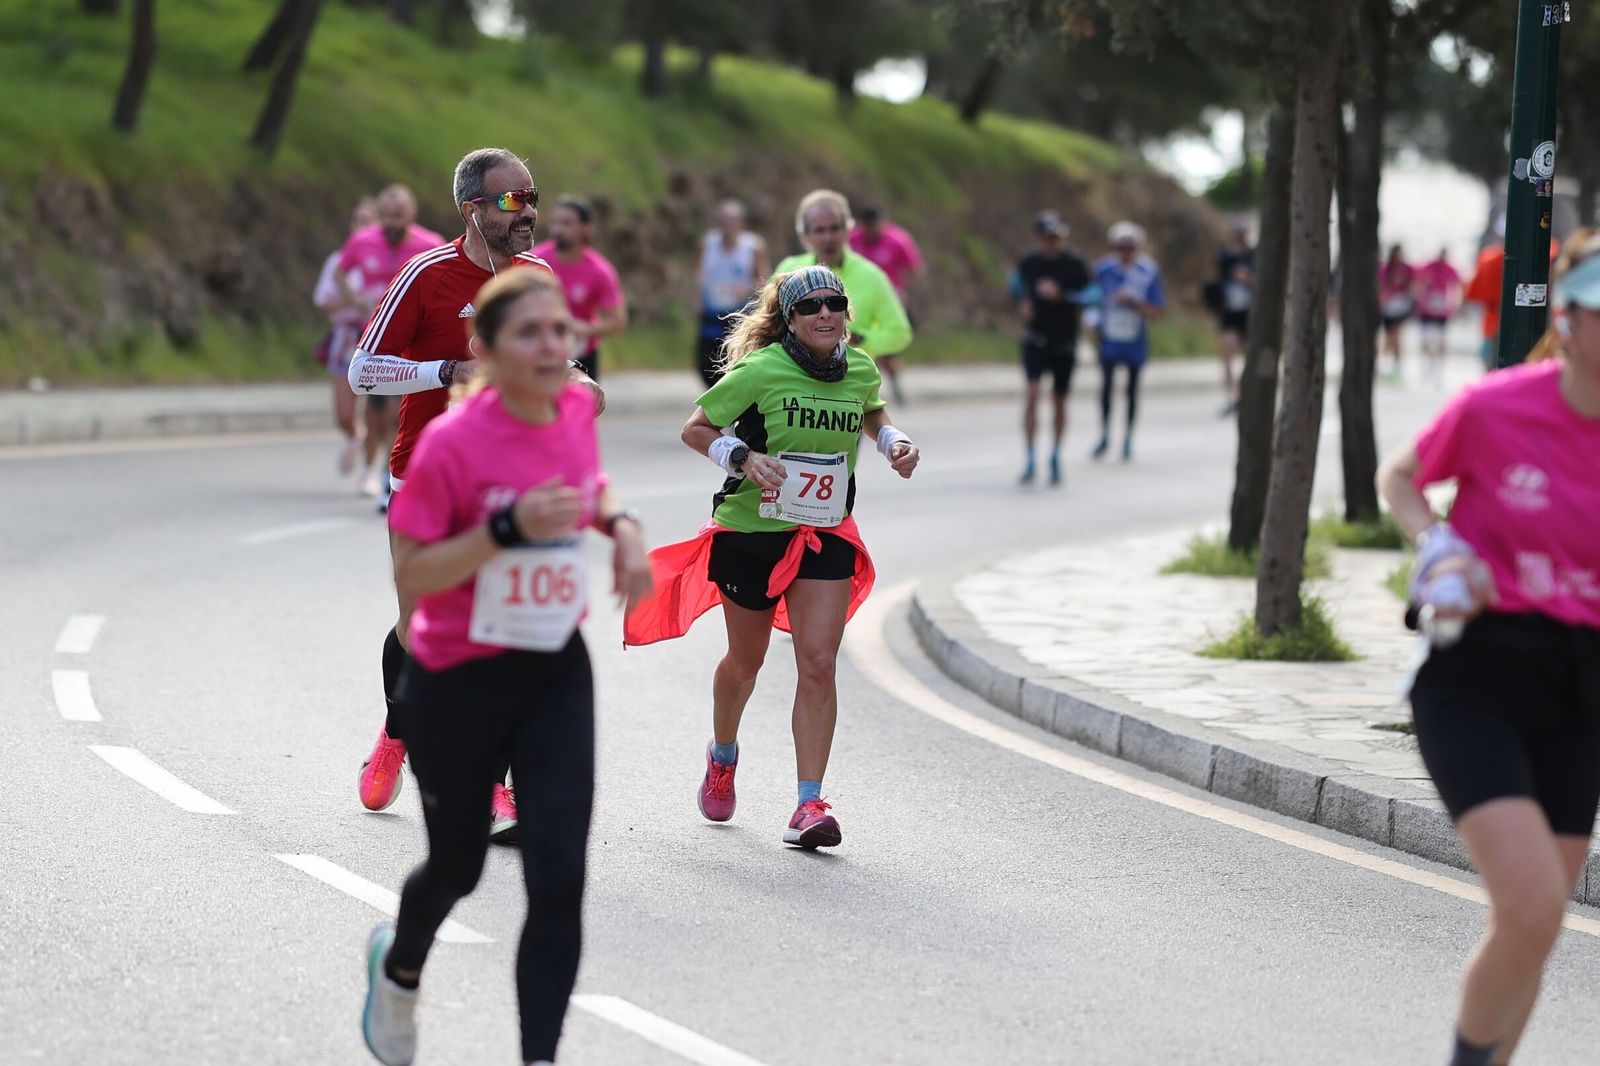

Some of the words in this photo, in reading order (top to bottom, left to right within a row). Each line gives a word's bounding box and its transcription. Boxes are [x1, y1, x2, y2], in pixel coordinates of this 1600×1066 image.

[358, 375, 374, 383] 2021
[394, 365, 419, 382] VIII
[783, 397, 799, 408] LA
[798, 472, 834, 501] 78
[503, 564, 578, 607] 106
